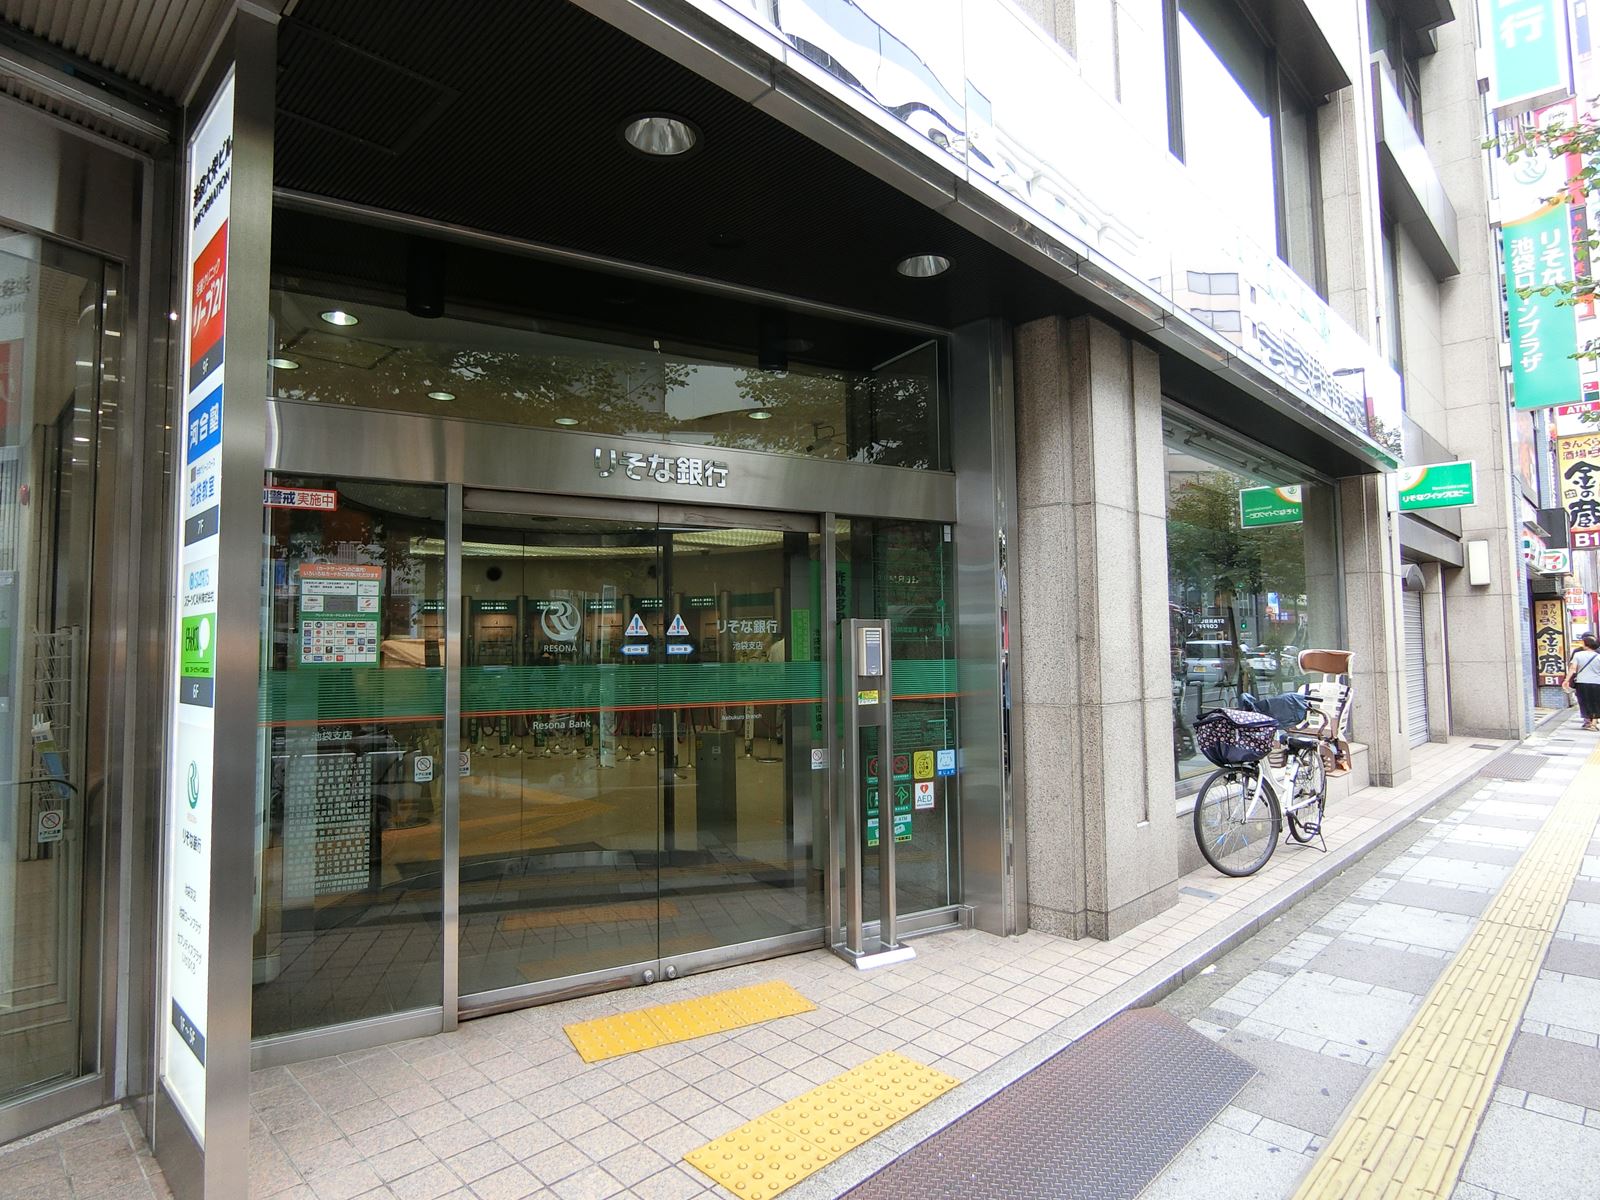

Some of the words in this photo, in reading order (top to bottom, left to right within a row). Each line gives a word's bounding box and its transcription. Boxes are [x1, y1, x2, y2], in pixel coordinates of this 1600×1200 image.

[193, 168, 230, 230] INFORMATION
[1540, 228, 1567, 286] りそな
[192, 272, 225, 338] リーブ21
[1566, 403, 1592, 414] ATM
[189, 402, 220, 449] 河合塾
[593, 447, 730, 488] りそな銀行
[1564, 460, 1600, 527] 金の蔵
[197, 518, 205, 535] 7F
[1575, 532, 1600, 547] B1
[716, 619, 778, 634] りそな銀行
[543, 644, 578, 653] RESONA
[732, 641, 765, 651] 池袋支店
[1536, 625, 1566, 675] 金の蔵
[1545, 676, 1560, 685] B1
[532, 720, 566, 730] Resona
[569, 719, 592, 729] Bank
[917, 795, 933, 804] AED
